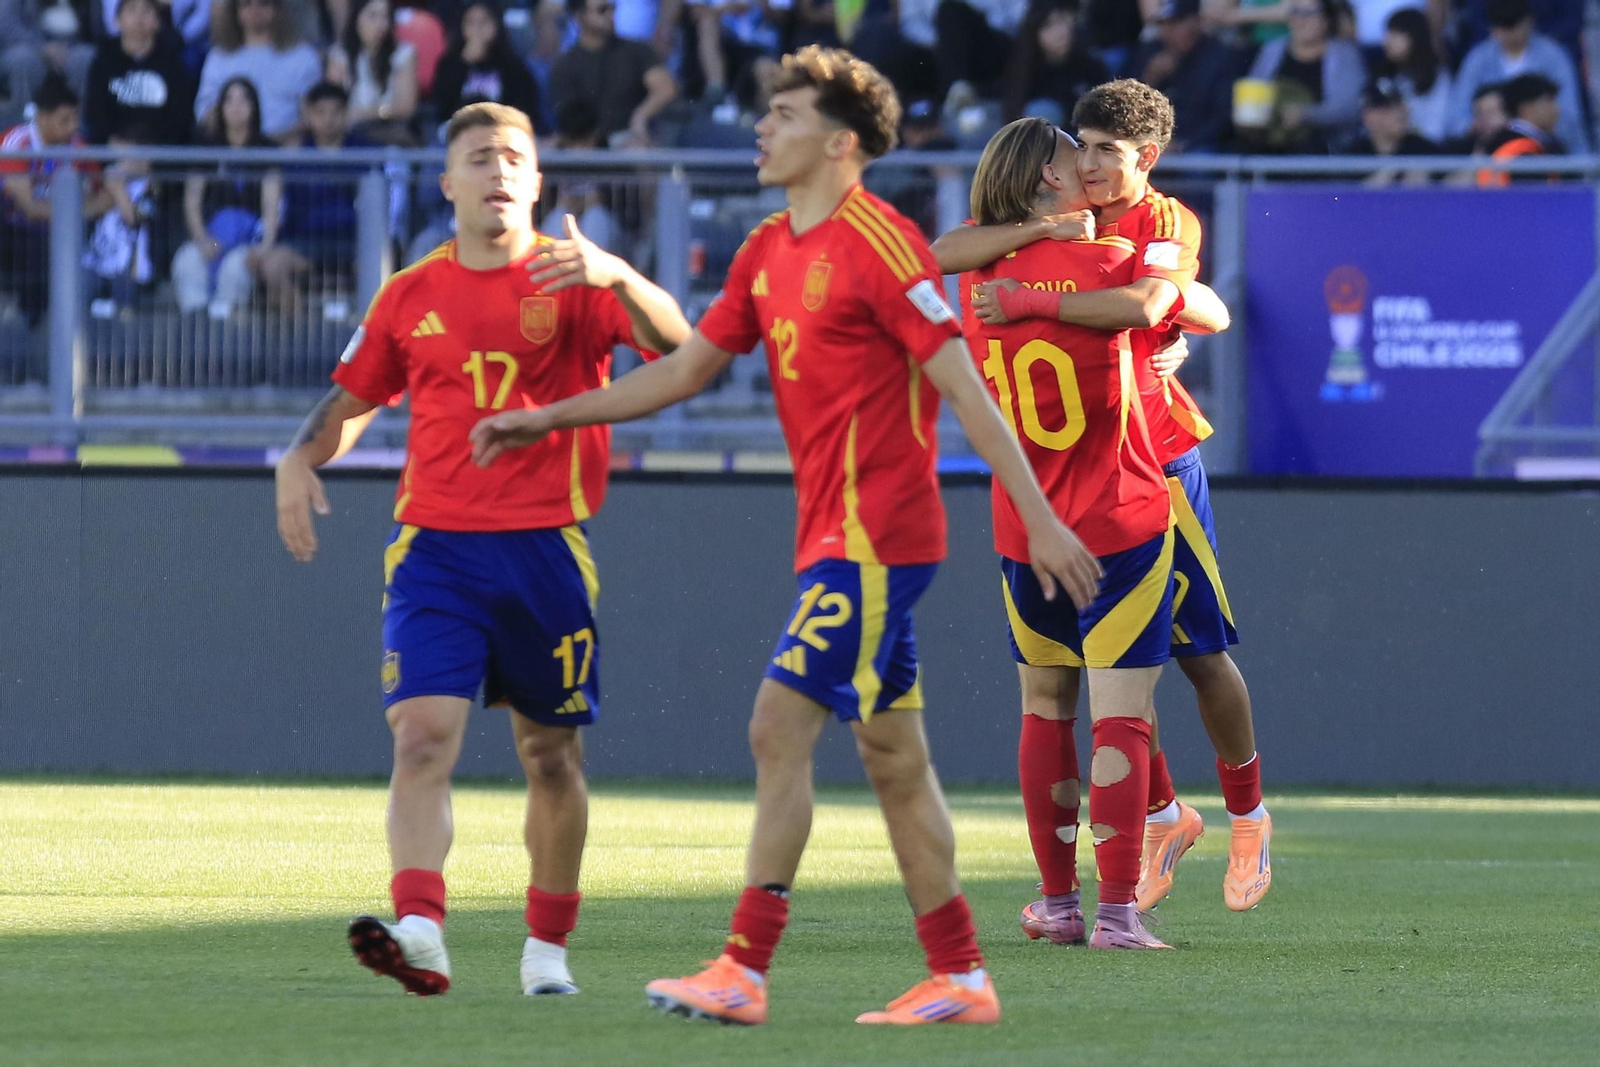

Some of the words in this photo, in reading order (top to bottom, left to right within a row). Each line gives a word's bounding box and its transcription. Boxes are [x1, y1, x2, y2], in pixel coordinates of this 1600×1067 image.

[461, 350, 519, 411] 17
[768, 316, 800, 382] 12
[982, 338, 1087, 452] 10
[787, 582, 853, 652] 12
[552, 627, 593, 690] 17
